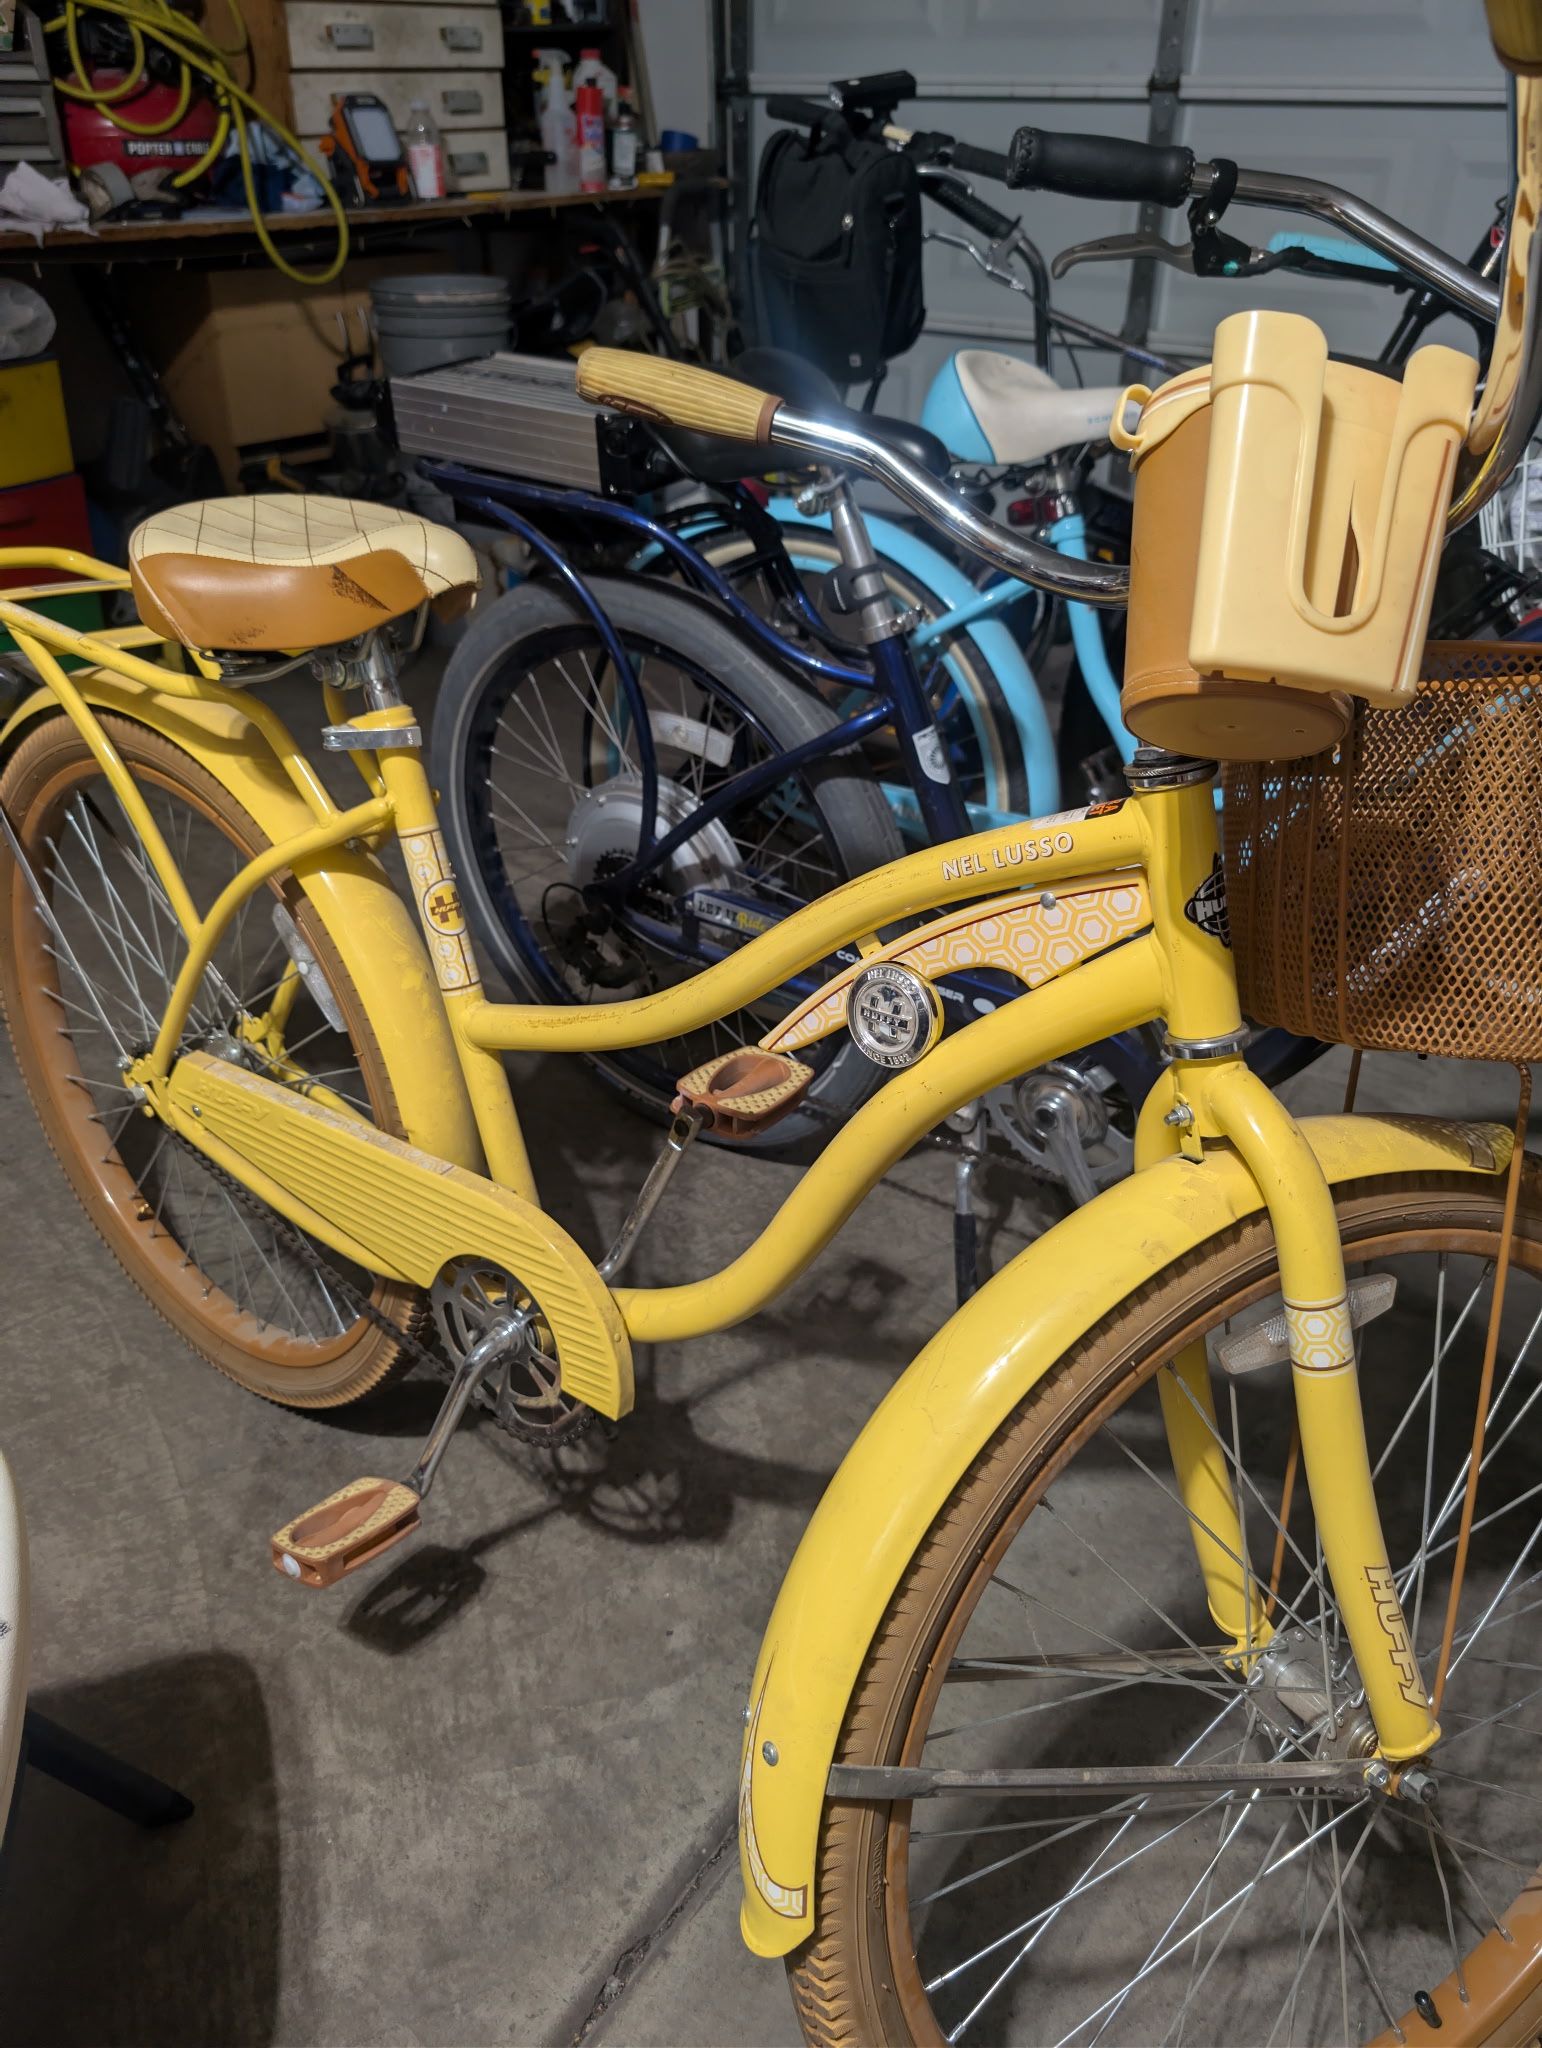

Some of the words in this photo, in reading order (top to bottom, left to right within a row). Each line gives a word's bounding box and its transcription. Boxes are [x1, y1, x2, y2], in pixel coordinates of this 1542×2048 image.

[127, 141, 173, 155] PORTER
[941, 853, 987, 880] NEL
[992, 832, 1074, 868] LUSSO
[862, 1009, 902, 1027] HUFFY
[1364, 1565, 1430, 1710] HUFFY
